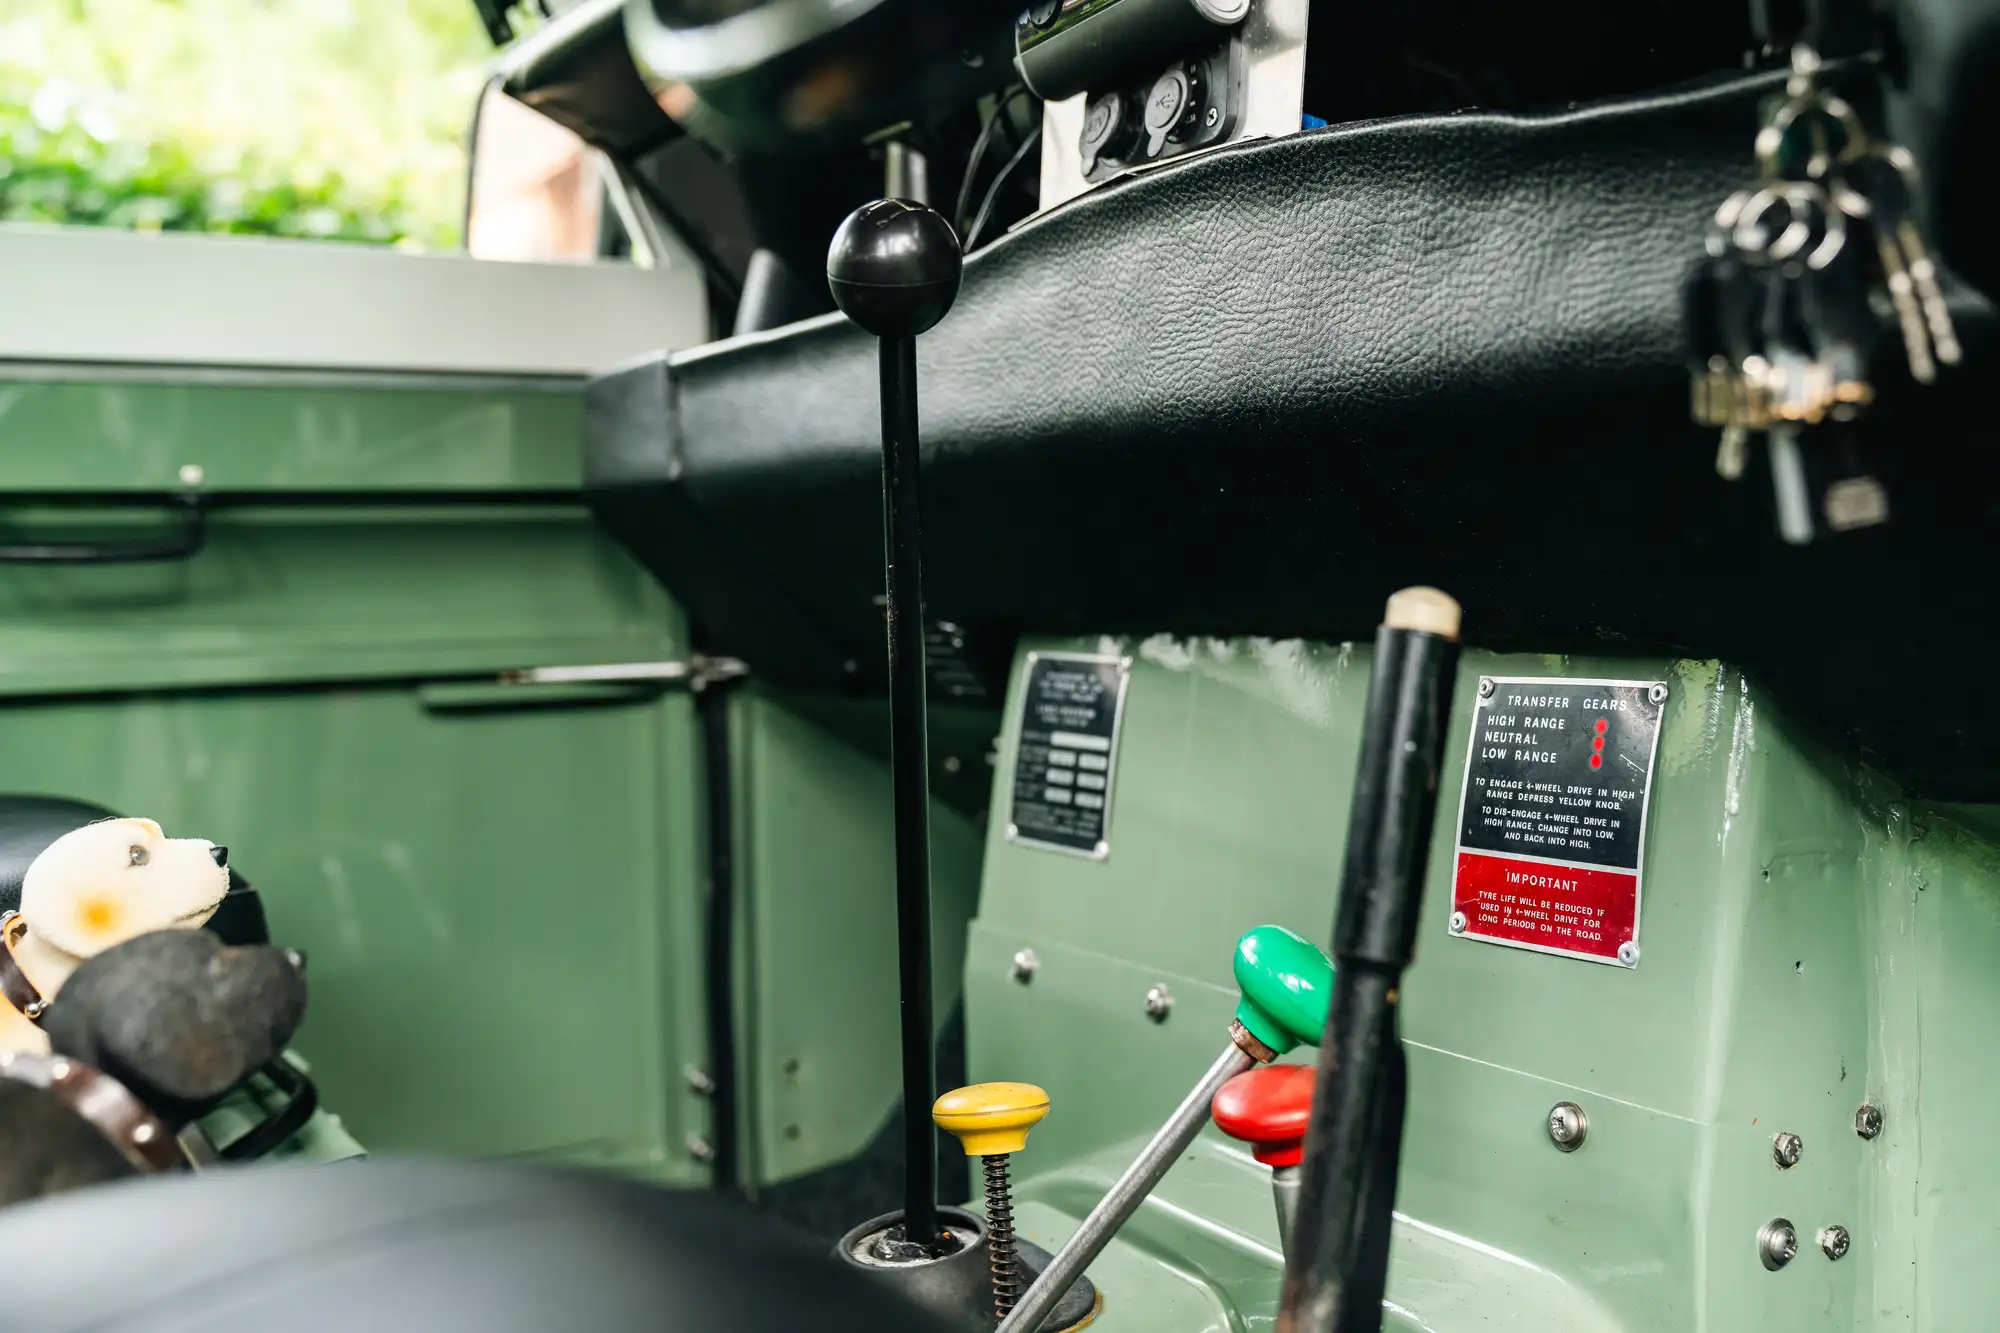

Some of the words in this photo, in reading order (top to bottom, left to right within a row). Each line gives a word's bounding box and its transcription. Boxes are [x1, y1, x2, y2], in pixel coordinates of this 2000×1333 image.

[1508, 695, 1569, 708] TRANSFER
[1583, 698, 1628, 711] GEARS
[1487, 715, 1516, 727] HIGH
[1524, 717, 1565, 730] RANGE
[1485, 732, 1538, 744] NEUTRAL
[1482, 748, 1507, 760] LOW
[1515, 750, 1557, 764] RANGE
[1475, 778, 1485, 786] TO
[1489, 779, 1523, 790] ENGAGE
[1526, 782, 1562, 793] 4-WHEEL
[1567, 785, 1593, 796] DRIVE
[1598, 788, 1608, 797] IN
[1612, 790, 1635, 800] HIGH
[1486, 790, 1513, 800] RANGE
[1518, 793, 1554, 804] DEPRESS
[1559, 797, 1591, 808] YELLOW
[1595, 800, 1621, 811] KNOB.
[1482, 806, 1492, 814] TO
[1494, 807, 1542, 820] DIS-ENGAGE
[1544, 813, 1579, 824] 4-WHEEL
[1583, 816, 1607, 827] DRIVE
[1611, 820, 1620, 829] IN
[1484, 817, 1503, 827] HIGH
[1537, 823, 1569, 835] CHANGE
[1573, 827, 1592, 837] INTO
[1504, 831, 1521, 841] AND
[1524, 833, 1545, 844] BACK
[1547, 836, 1566, 846] INTO
[1569, 839, 1591, 849] HIGH.
[1506, 872, 1578, 891] IMPORTANT
[1479, 890, 1497, 901] TYRE
[1500, 894, 1516, 904] LIFE
[1519, 897, 1537, 907] WILL
[1541, 900, 1551, 909] BE
[1555, 902, 1593, 915] REDUCED
[1597, 908, 1605, 917] IF
[1480, 902, 1500, 912] USED
[1504, 905, 1512, 915] IN
[1515, 908, 1549, 921] 4-WHEEL
[1554, 913, 1578, 926] DRIVE
[1583, 918, 1601, 929] FOR
[1478, 913, 1498, 924] LONG
[1503, 917, 1536, 930] PERIODS
[1540, 923, 1552, 933] ON
[1557, 926, 1572, 937] THE
[1576, 929, 1602, 941] ROAD.
